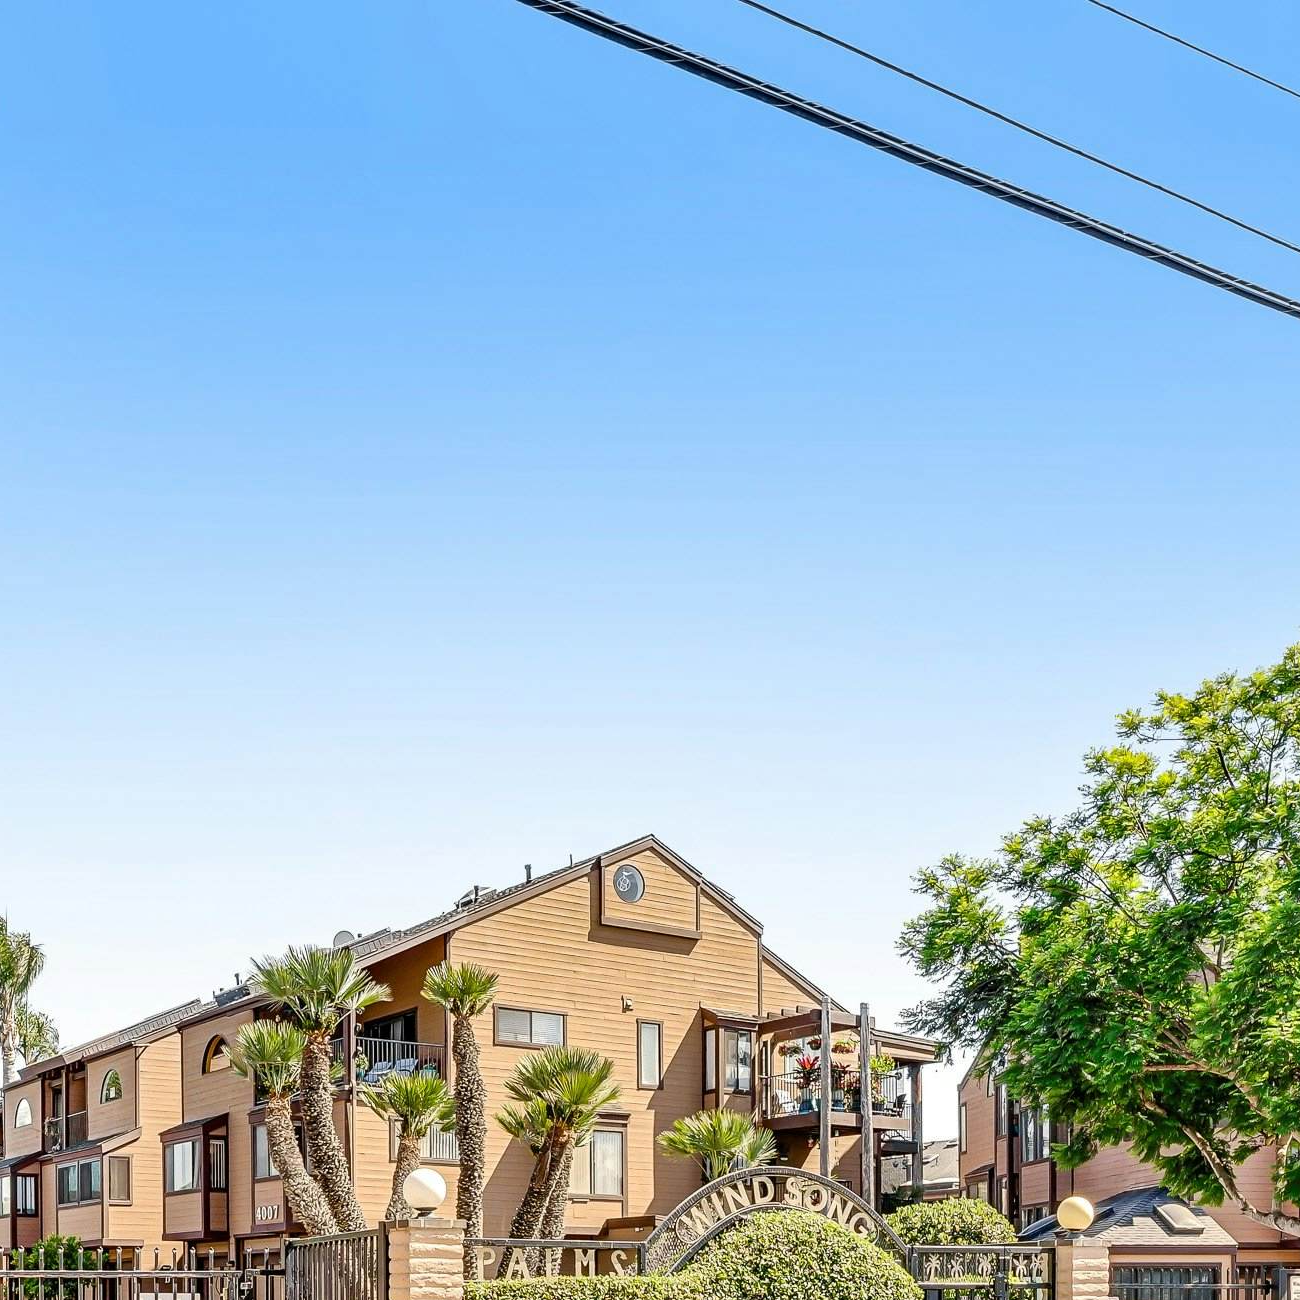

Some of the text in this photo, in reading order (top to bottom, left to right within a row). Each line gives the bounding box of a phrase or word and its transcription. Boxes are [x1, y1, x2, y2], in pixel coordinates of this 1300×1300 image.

[256, 1205, 279, 1221] 4007
[680, 1176, 876, 1238] WIND SONG
[475, 1247, 628, 1281] PALMS
